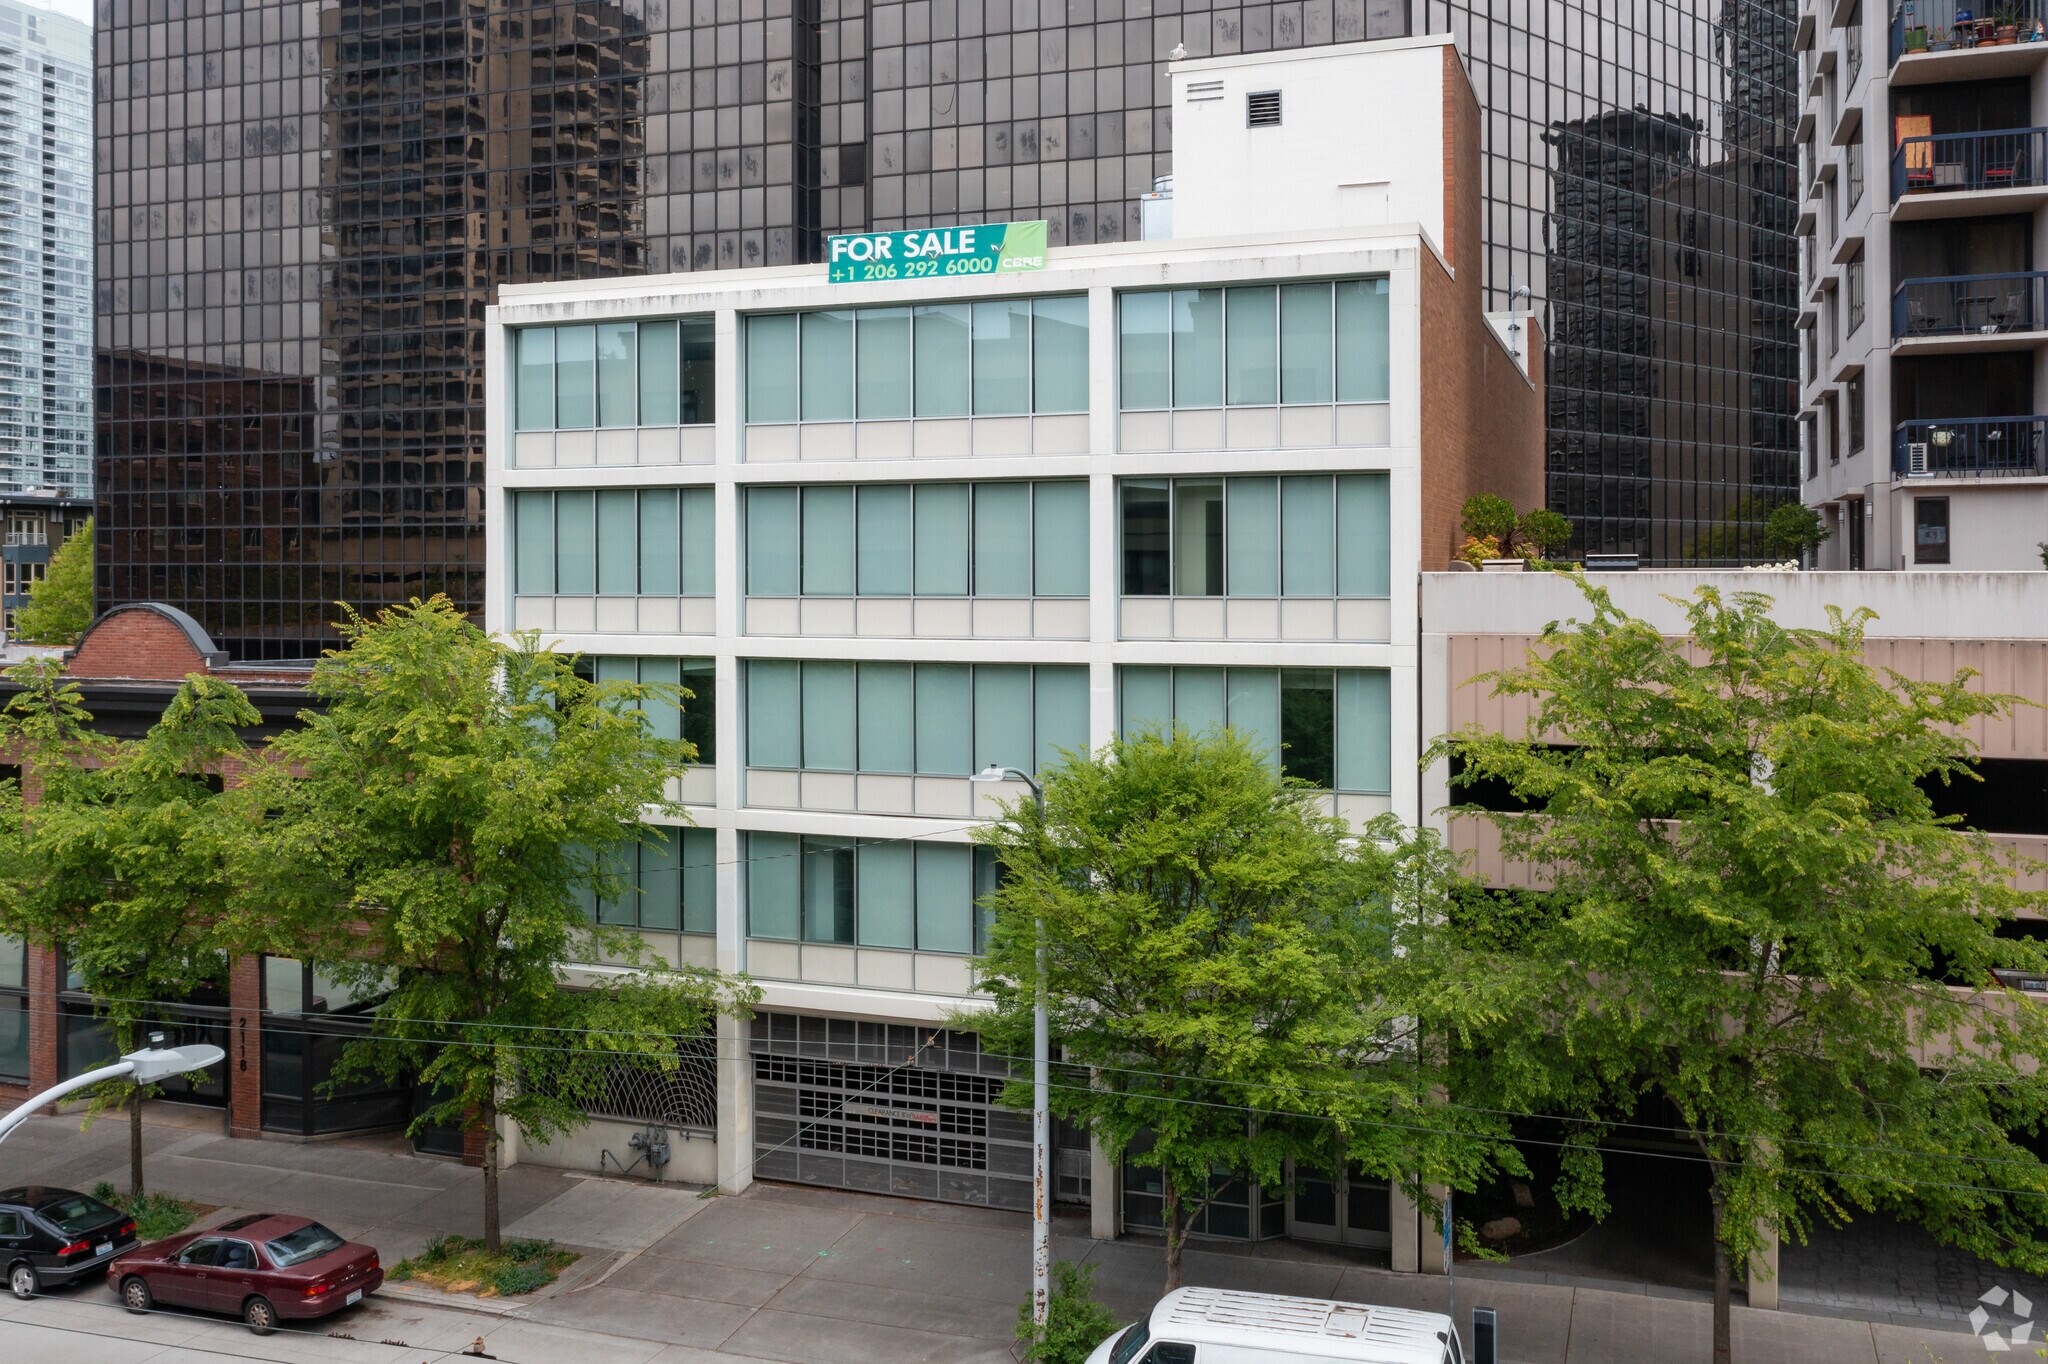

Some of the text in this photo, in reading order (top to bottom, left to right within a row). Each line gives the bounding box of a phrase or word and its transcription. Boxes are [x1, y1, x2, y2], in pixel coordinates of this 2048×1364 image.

[832, 229, 975, 263] FOR SALE
[832, 257, 993, 281] +1 206 292 6000
[1002, 256, 1043, 268] CBRE
[867, 1107, 901, 1118] CLEARANCE
